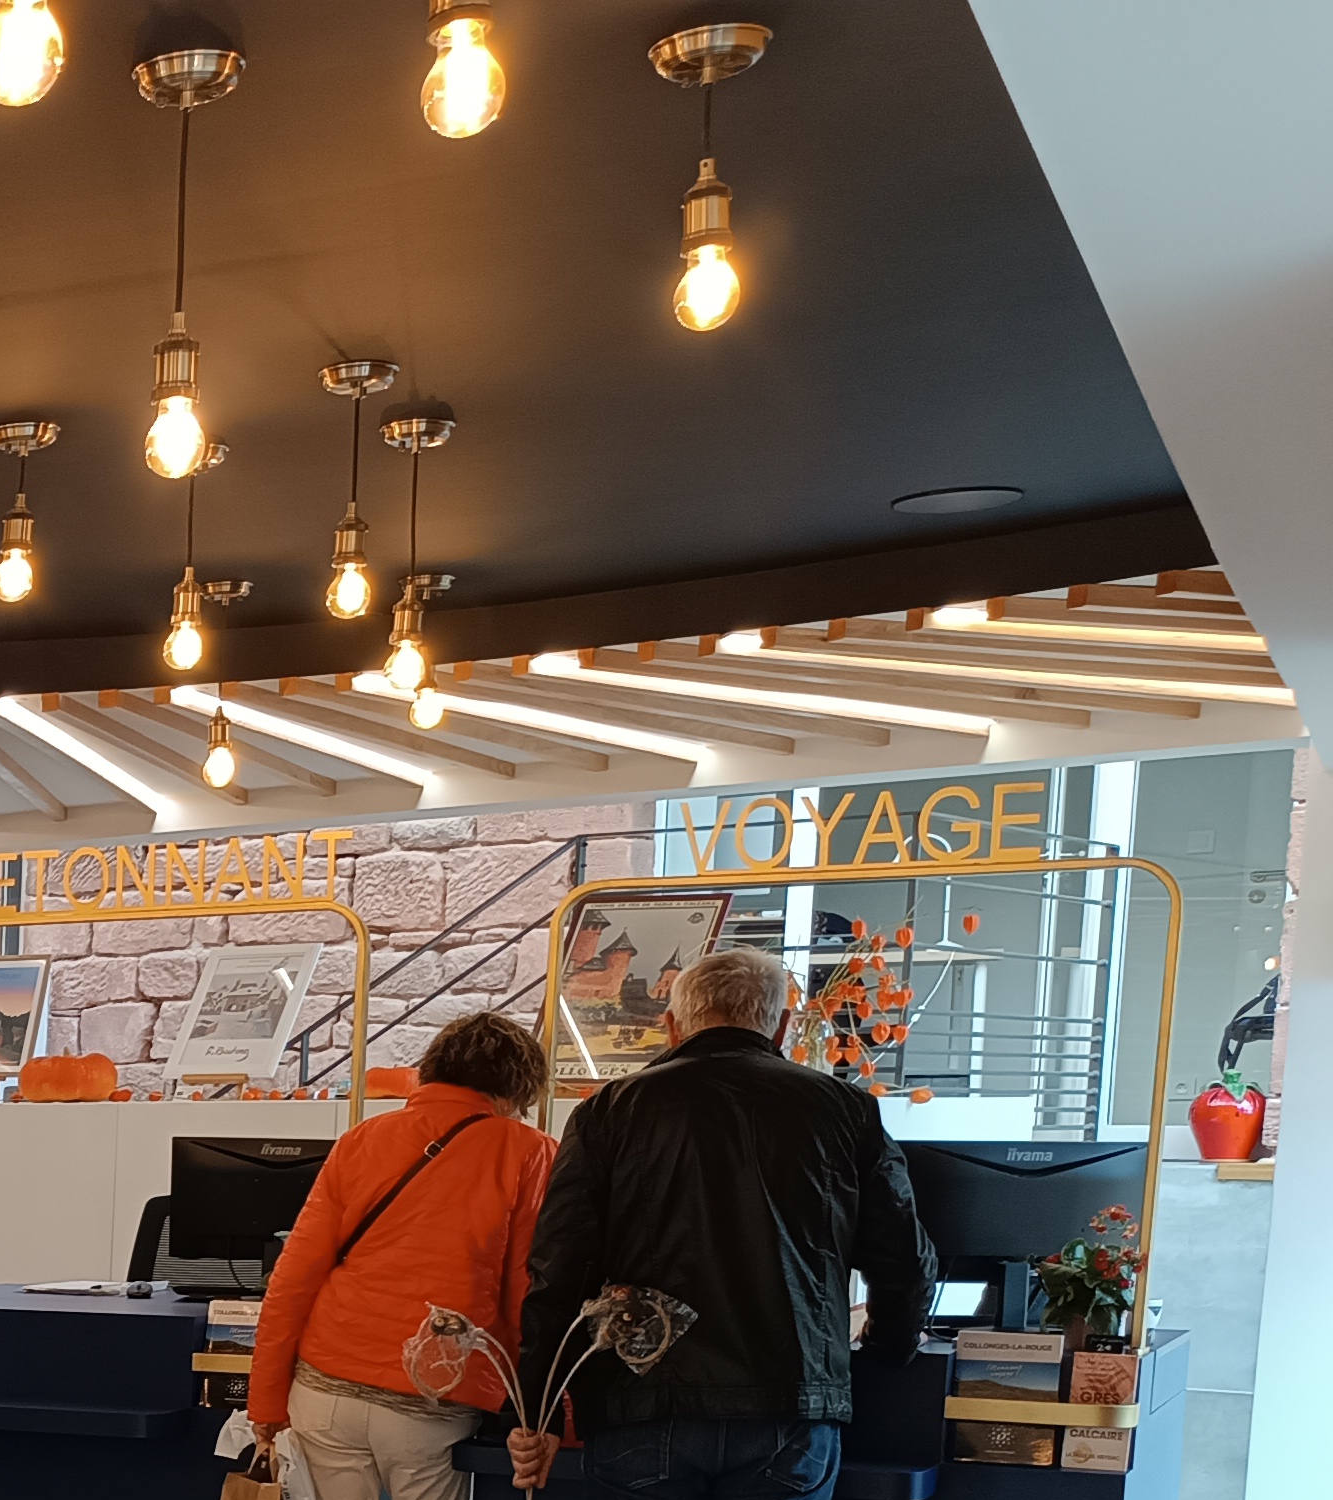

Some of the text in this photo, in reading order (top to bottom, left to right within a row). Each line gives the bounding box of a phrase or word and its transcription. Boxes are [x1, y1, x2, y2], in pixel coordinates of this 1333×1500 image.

[680, 782, 1044, 875] VOYAGE
[260, 1143, 302, 1156] iiyama
[1007, 1147, 1053, 1161] iiyama
[963, 1342, 1052, 1352] COLLONGES-LA-ROUGE
[1069, 1428, 1124, 1441] CALCAIRE
